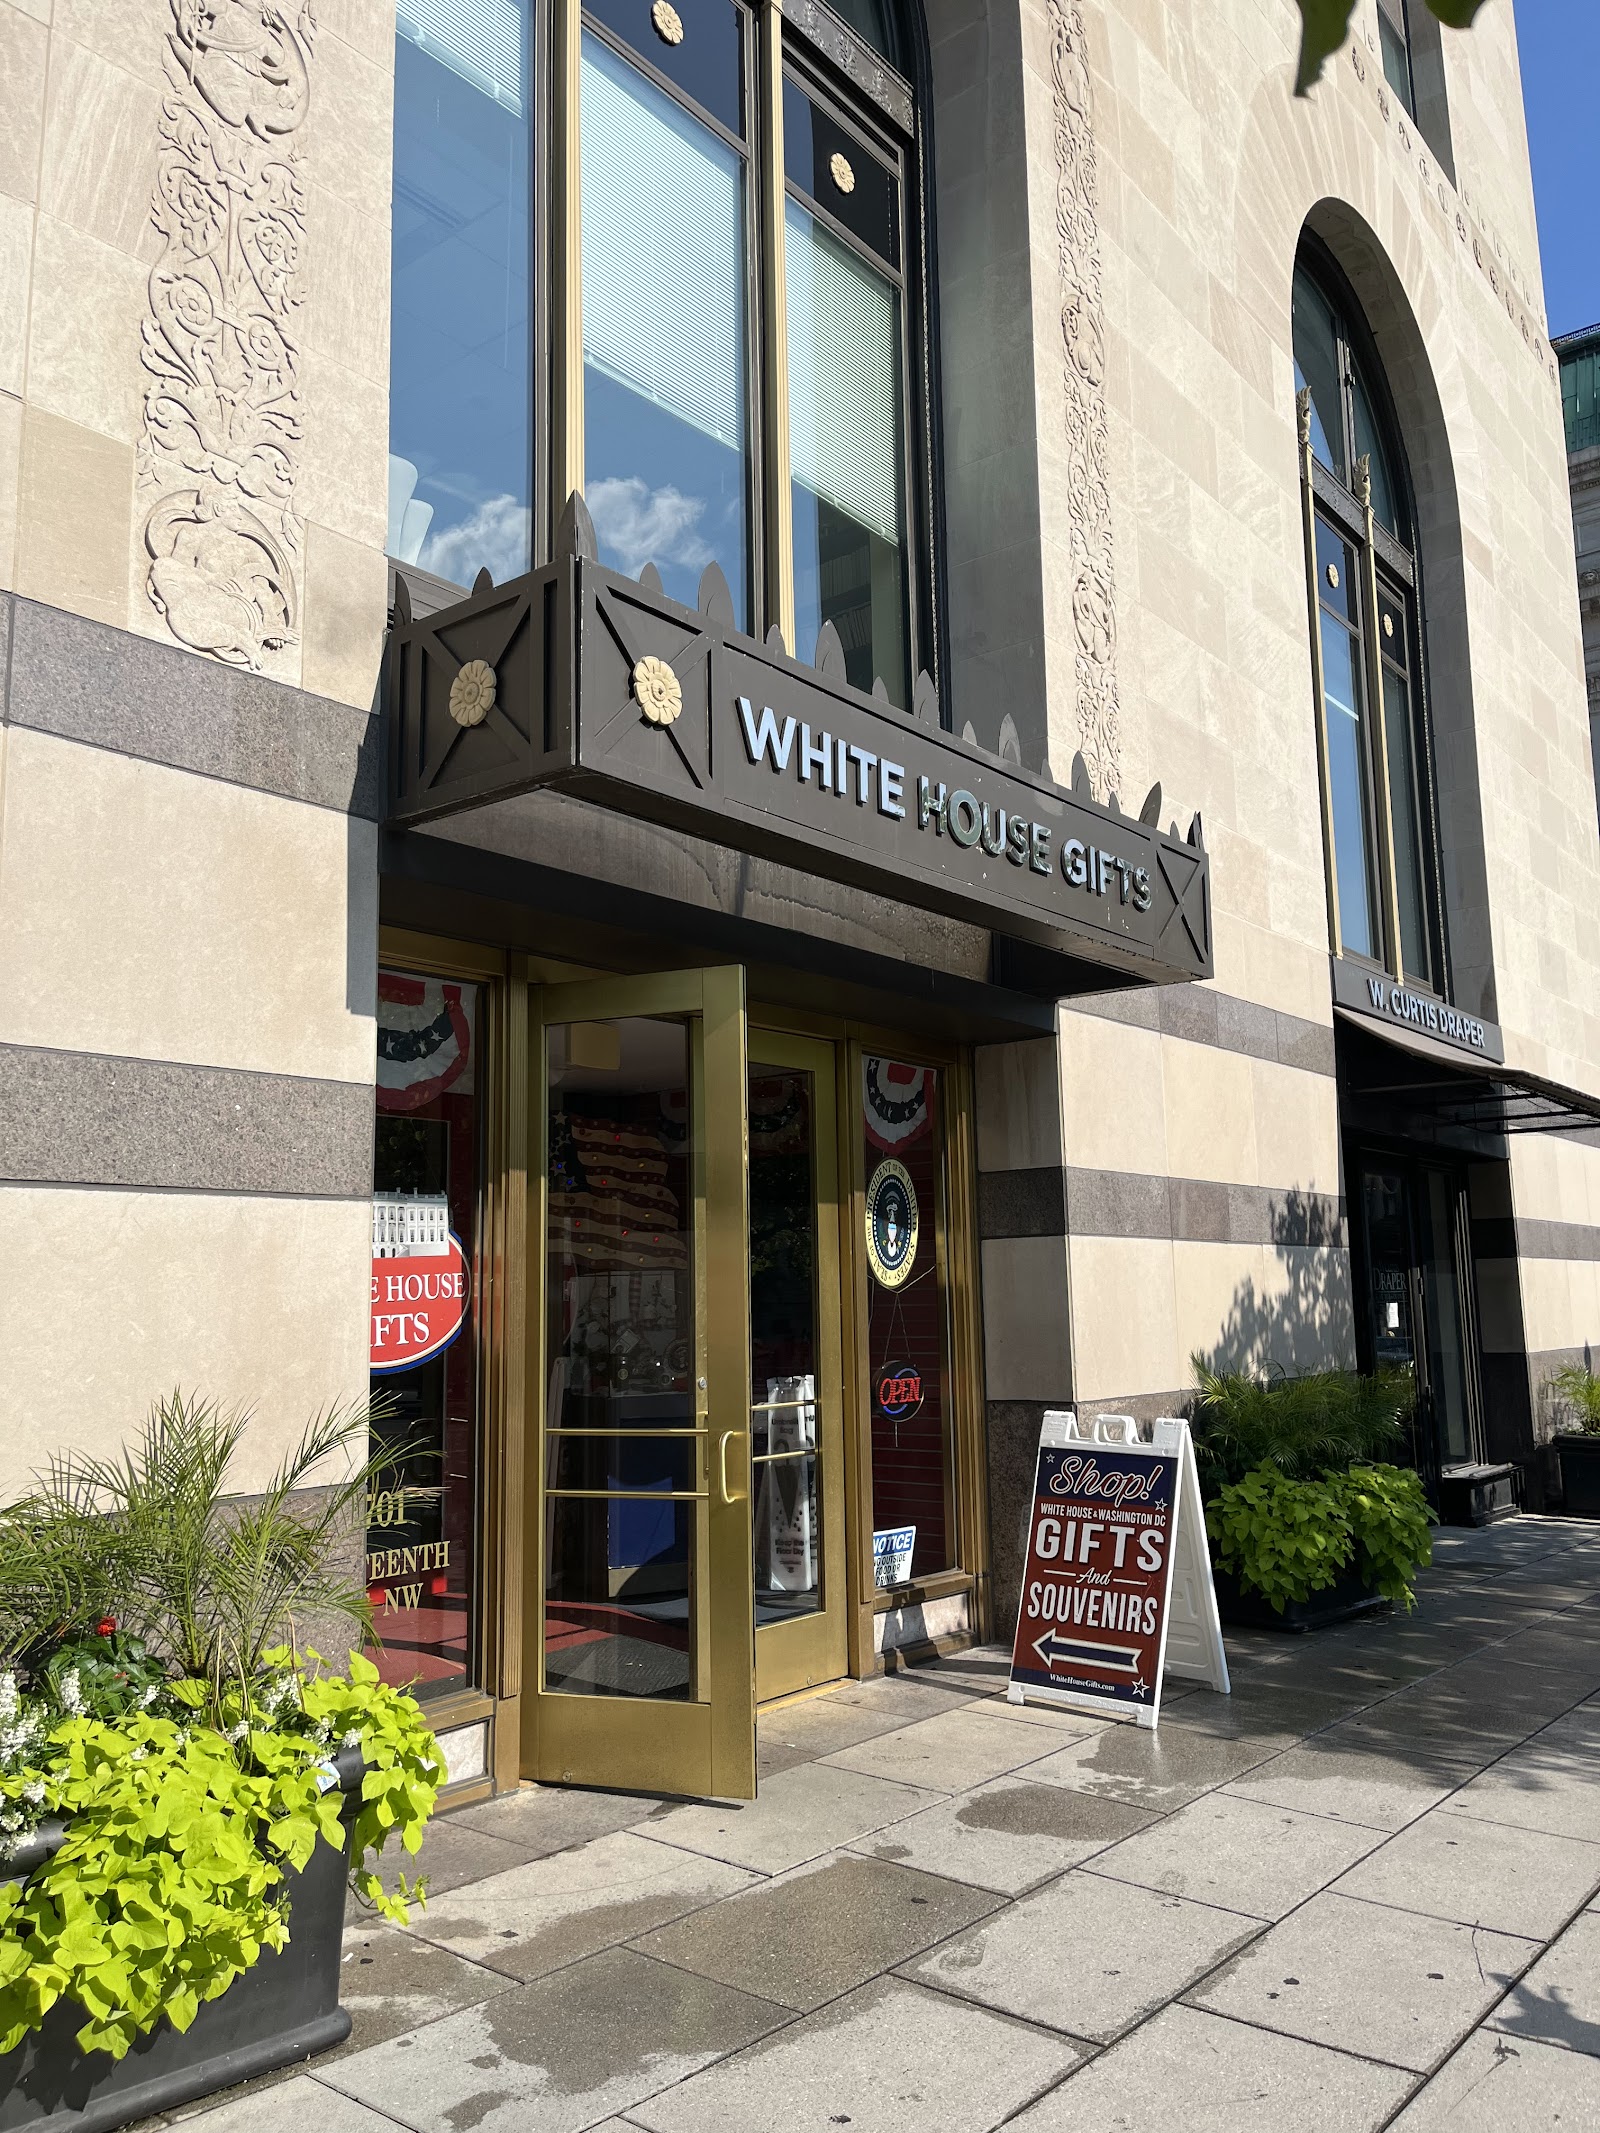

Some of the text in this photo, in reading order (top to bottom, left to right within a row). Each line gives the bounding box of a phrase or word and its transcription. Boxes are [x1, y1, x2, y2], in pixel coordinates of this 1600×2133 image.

[736, 696, 1153, 912] WHITE HOUSE GIFTS
[1367, 978, 1486, 1048] W. CURTIS DRAPER
[866, 1161, 892, 1220] PRESIDENT
[906, 1177, 918, 1232] UNITED
[385, 1272, 466, 1302] HOUSE
[1373, 1267, 1408, 1291] DRAPER
[371, 1312, 429, 1348] FTS
[879, 1376, 921, 1405] OPEN
[1049, 1455, 1163, 1507] Shop!
[1040, 1502, 1166, 1527] WHITE HOUSE & WASHINGTON DC
[873, 1532, 912, 1554] NOTICE
[1035, 1518, 1165, 1572] GIFTS
[366, 1540, 451, 1580] EENTH
[875, 1564, 891, 1577] FOOD
[881, 1552, 907, 1566] OUTSIDE
[875, 1573, 898, 1586] DRINKS
[1076, 1567, 1111, 1586] And
[383, 1582, 424, 1617] NW
[1027, 1581, 1158, 1636] SOUVENIRS
[1049, 1673, 1115, 1692] WhiteHouseGifts.com
